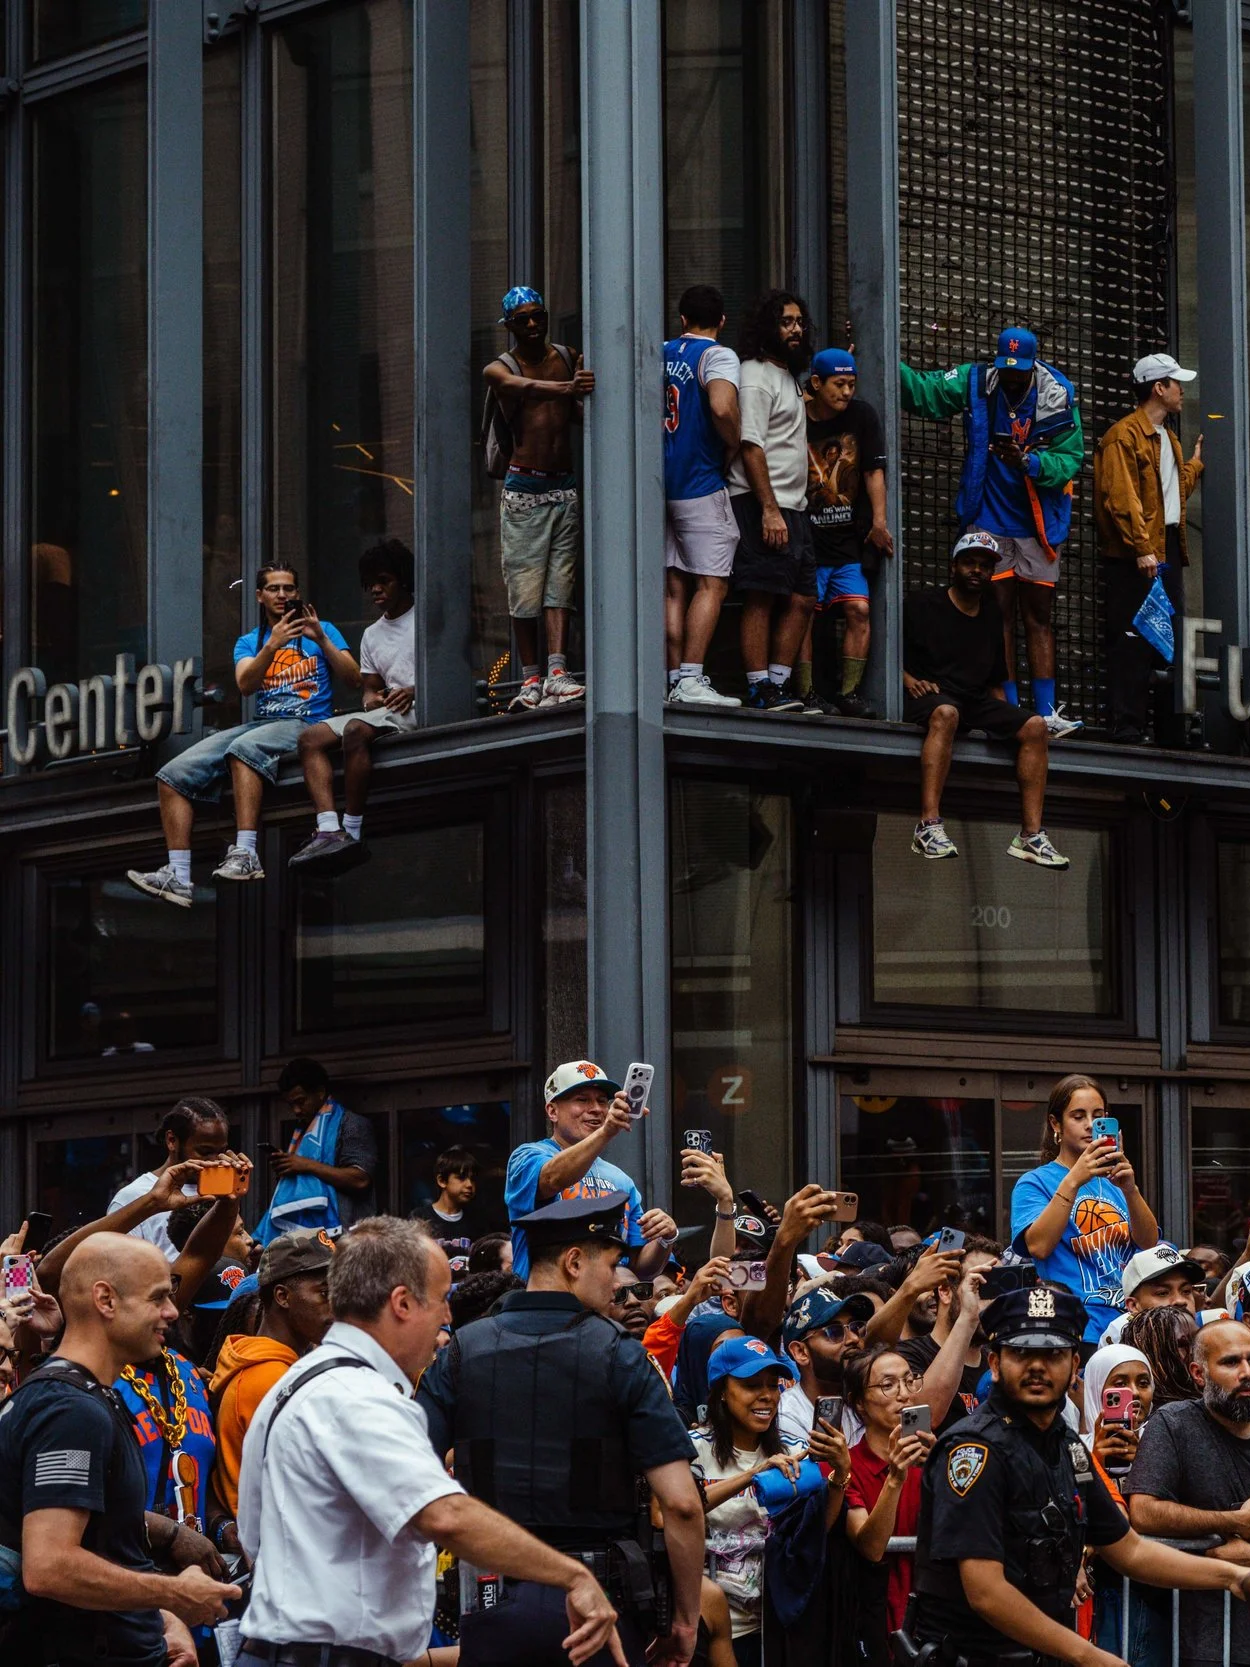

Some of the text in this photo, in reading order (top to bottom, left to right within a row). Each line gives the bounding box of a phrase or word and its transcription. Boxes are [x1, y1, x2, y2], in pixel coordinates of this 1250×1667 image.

[7, 652, 201, 766] Center
[971, 905, 1011, 929] 200
[721, 1075, 745, 1104] Z
